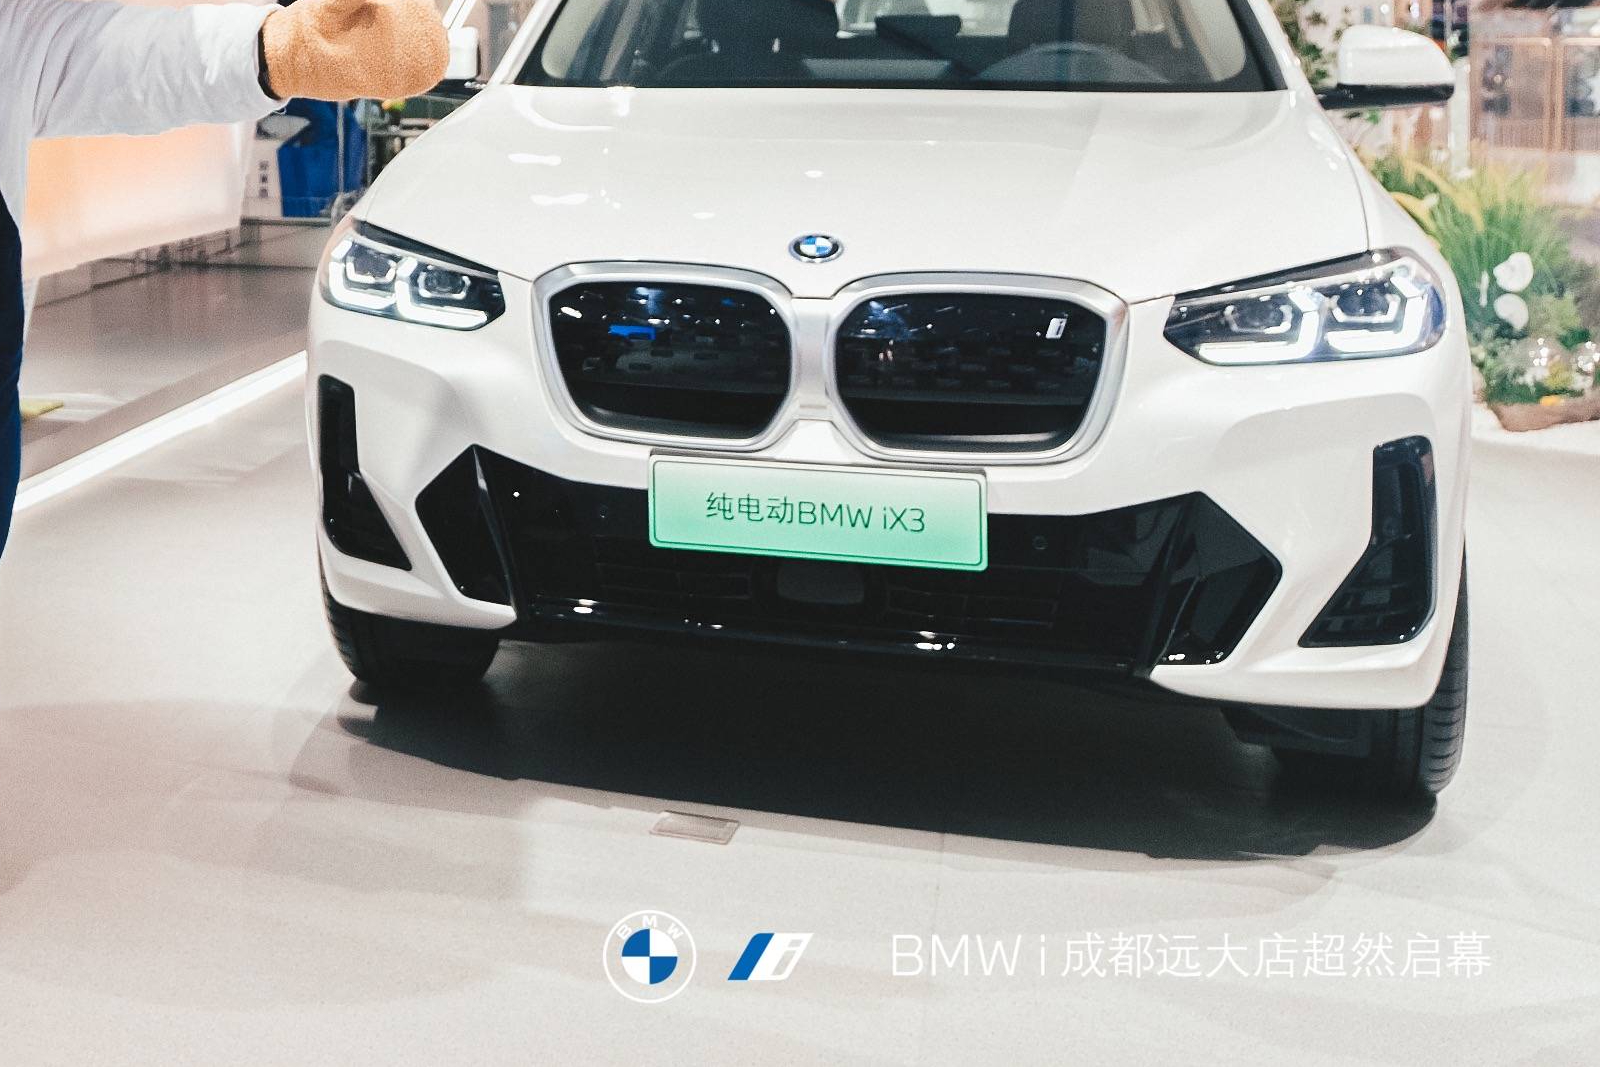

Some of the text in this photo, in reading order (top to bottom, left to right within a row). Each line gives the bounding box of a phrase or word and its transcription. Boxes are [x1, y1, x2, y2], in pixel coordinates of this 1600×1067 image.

[705, 491, 926, 533] 纯电动BMW iX3
